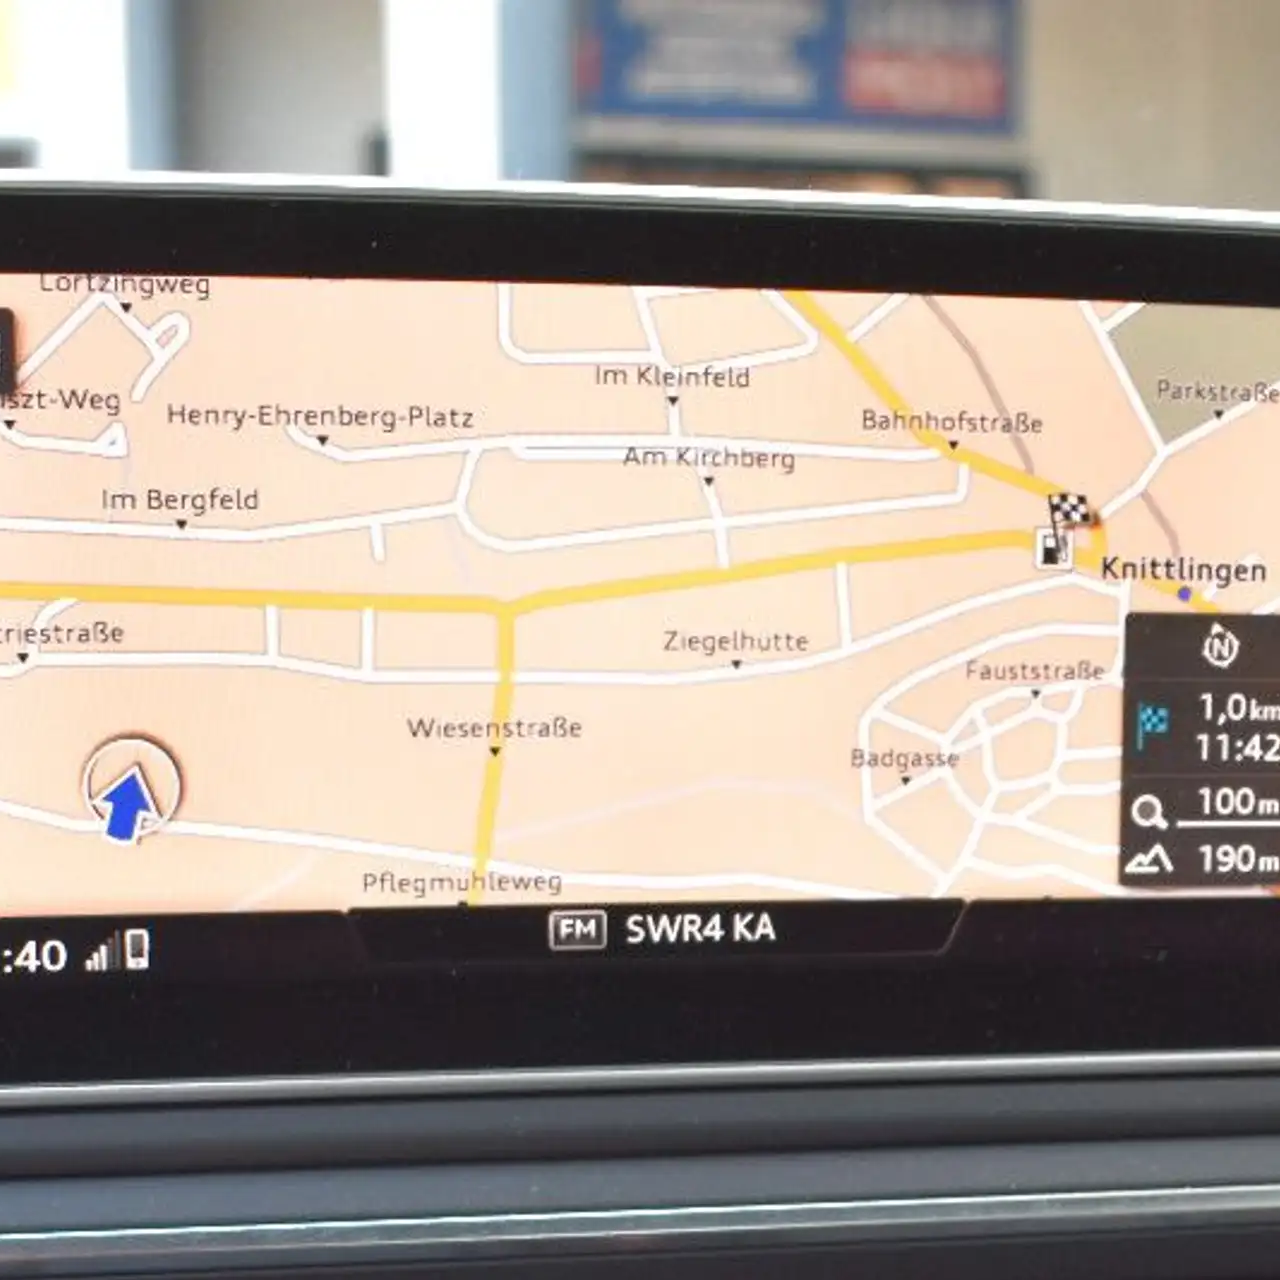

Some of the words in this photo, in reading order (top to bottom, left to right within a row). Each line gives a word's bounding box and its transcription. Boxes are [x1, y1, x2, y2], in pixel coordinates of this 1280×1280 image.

[594, 366, 628, 385] Im
[637, 366, 750, 388] Kleinfeld
[1157, 379, 1280, 403] Parkstraße
[167, 403, 474, 432] Henry-Ehrenberg-Platz
[861, 409, 1043, 434] Bahnhofstraße
[623, 447, 666, 466] Am
[676, 447, 796, 474] Kirchberg
[102, 489, 136, 509] Im
[147, 487, 259, 517] Bergfeld
[1101, 556, 1267, 583] Knittlingen
[966, 660, 1105, 681] Fauststraße
[407, 716, 583, 741] Wiesenstraße
[851, 748, 960, 774] Badgasse
[558, 918, 597, 940] FM
[626, 914, 726, 943] SWR4
[733, 911, 777, 942] KA
